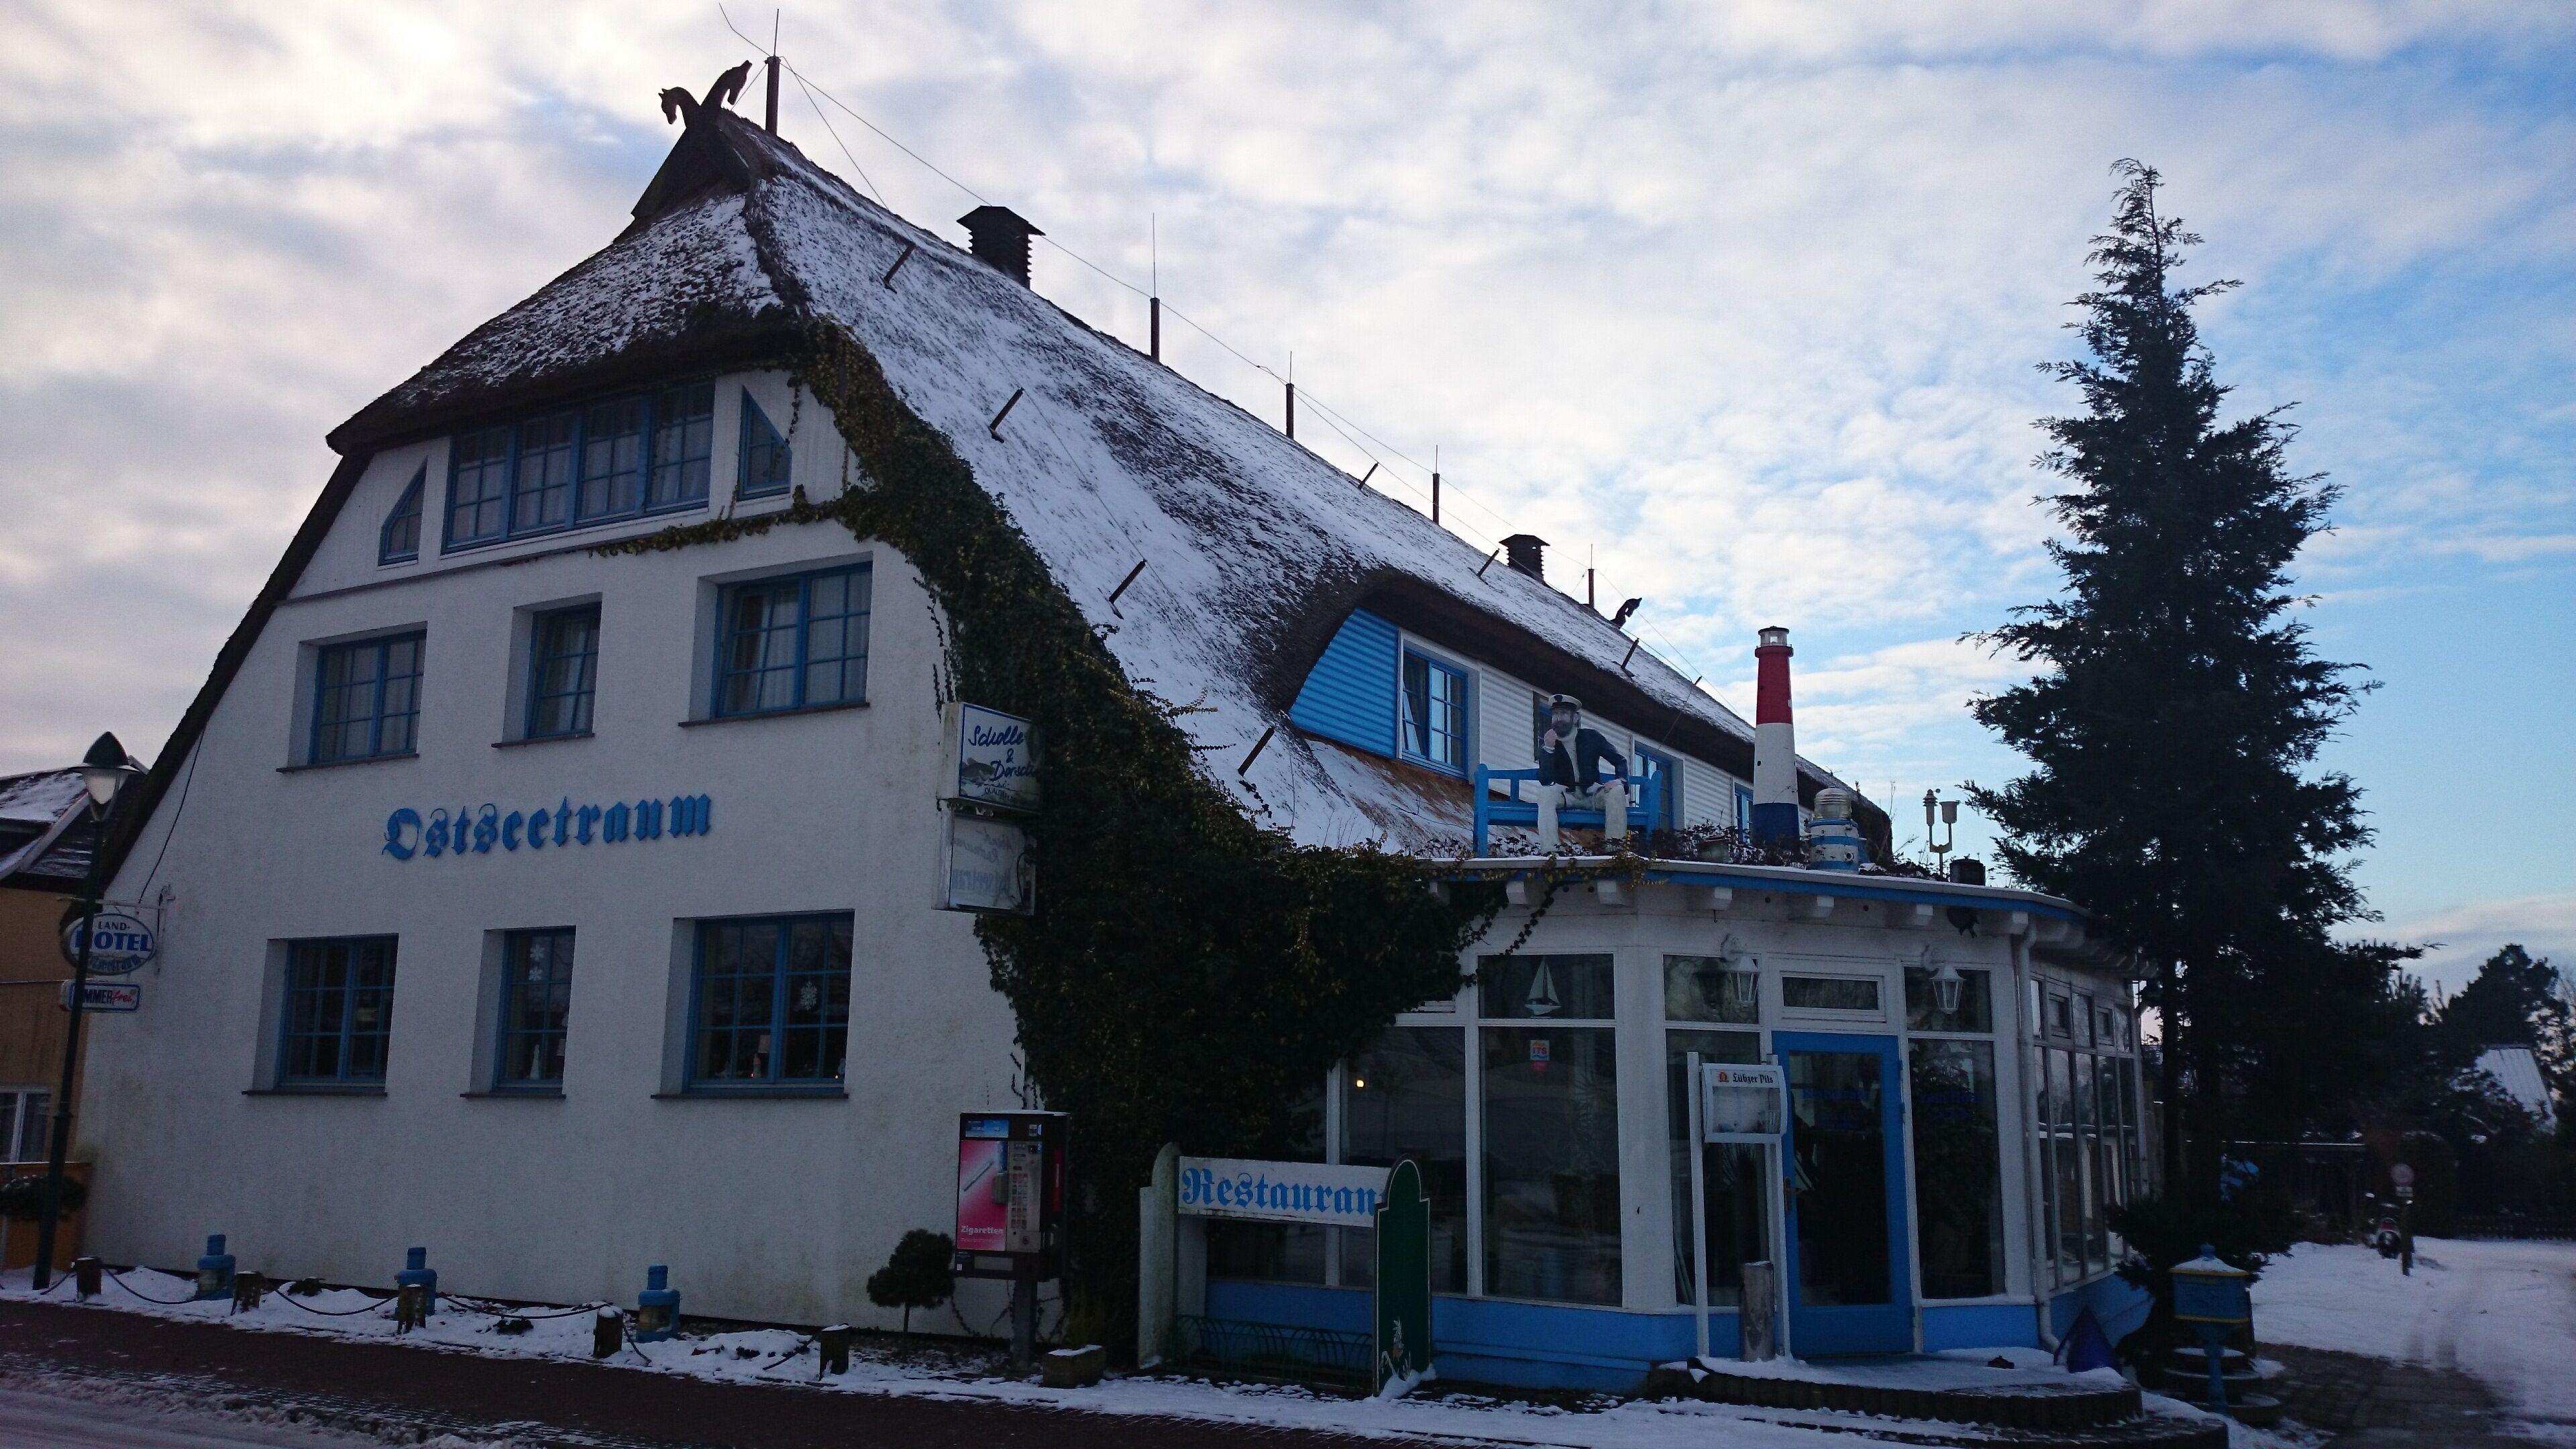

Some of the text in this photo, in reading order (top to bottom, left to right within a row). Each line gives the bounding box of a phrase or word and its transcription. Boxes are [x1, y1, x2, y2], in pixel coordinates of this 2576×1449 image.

[968, 725, 1024, 747] Scholle
[1006, 747, 1014, 763] &
[382, 794, 712, 860] Ostseetraum
[1733, 1073, 1774, 1084] Lübzer Pils
[961, 1226, 1004, 1236] Zigaretten
